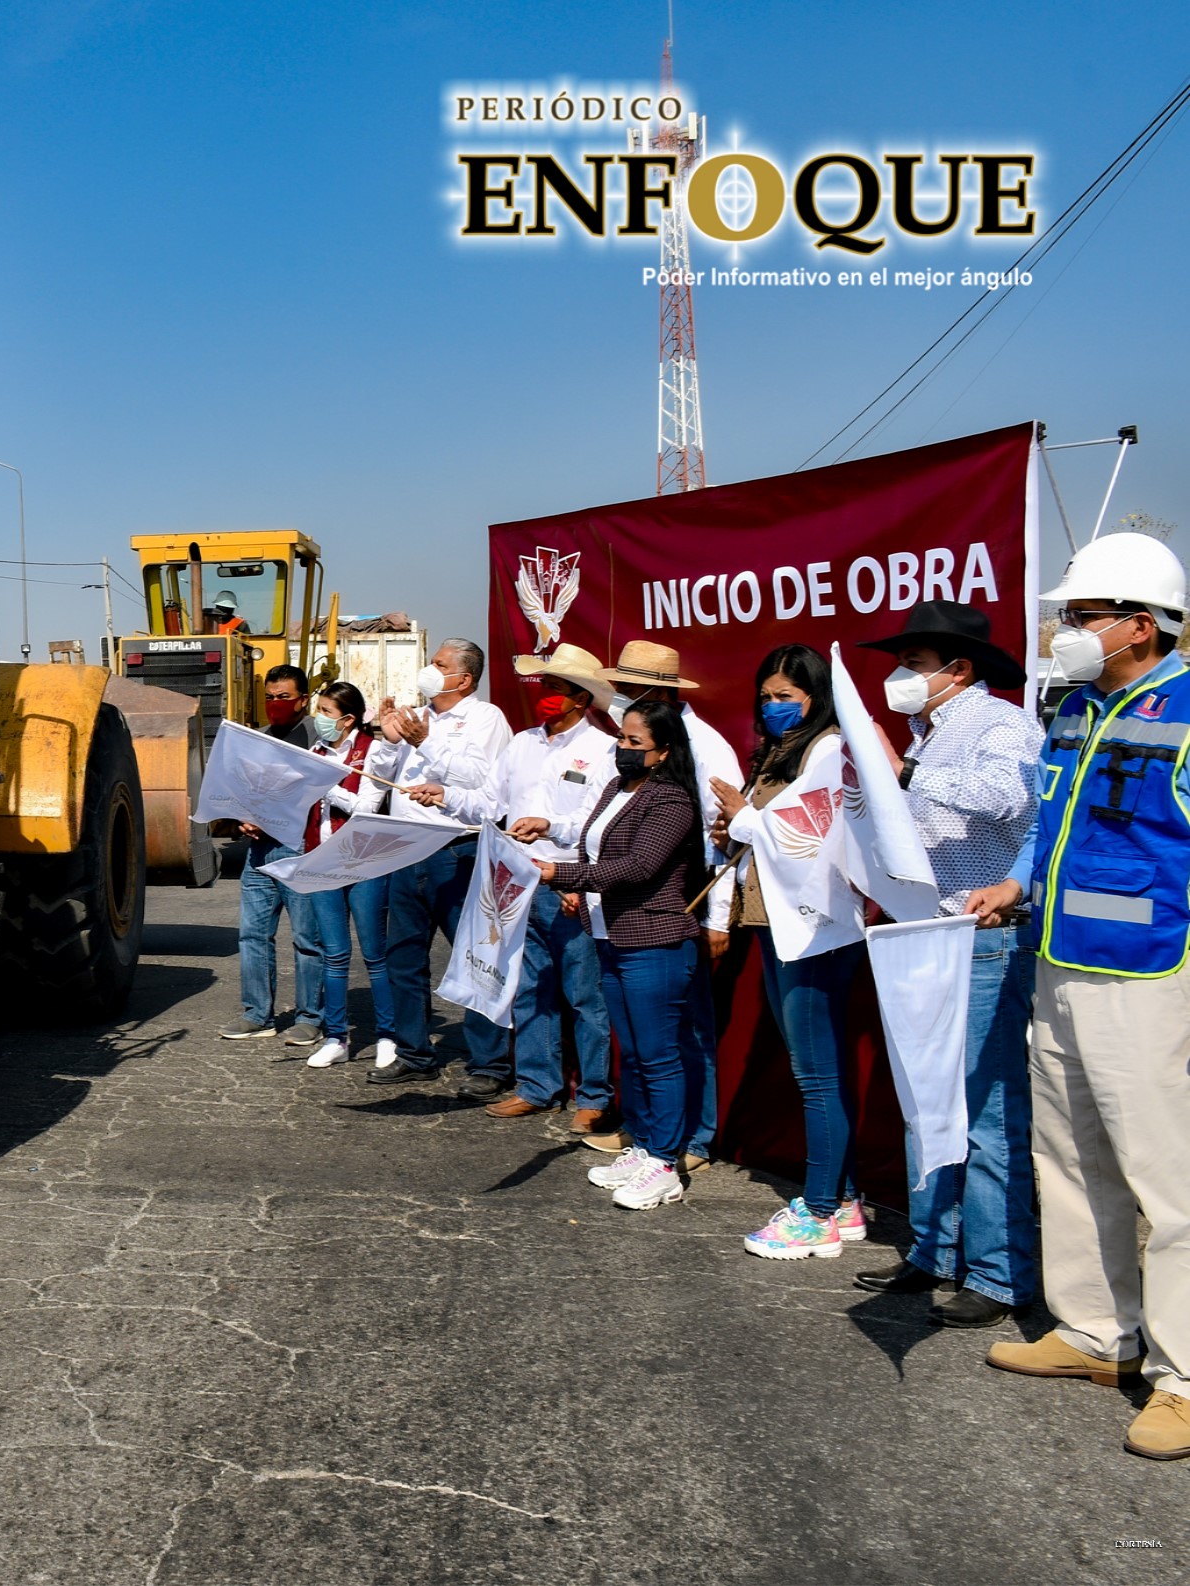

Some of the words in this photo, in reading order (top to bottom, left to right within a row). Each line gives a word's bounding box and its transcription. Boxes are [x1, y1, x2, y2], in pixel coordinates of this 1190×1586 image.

[642, 570, 762, 630] INICIO
[772, 561, 836, 620] DE
[847, 542, 1000, 614] OBRA
[148, 641, 202, 652] CATERPILLAR
